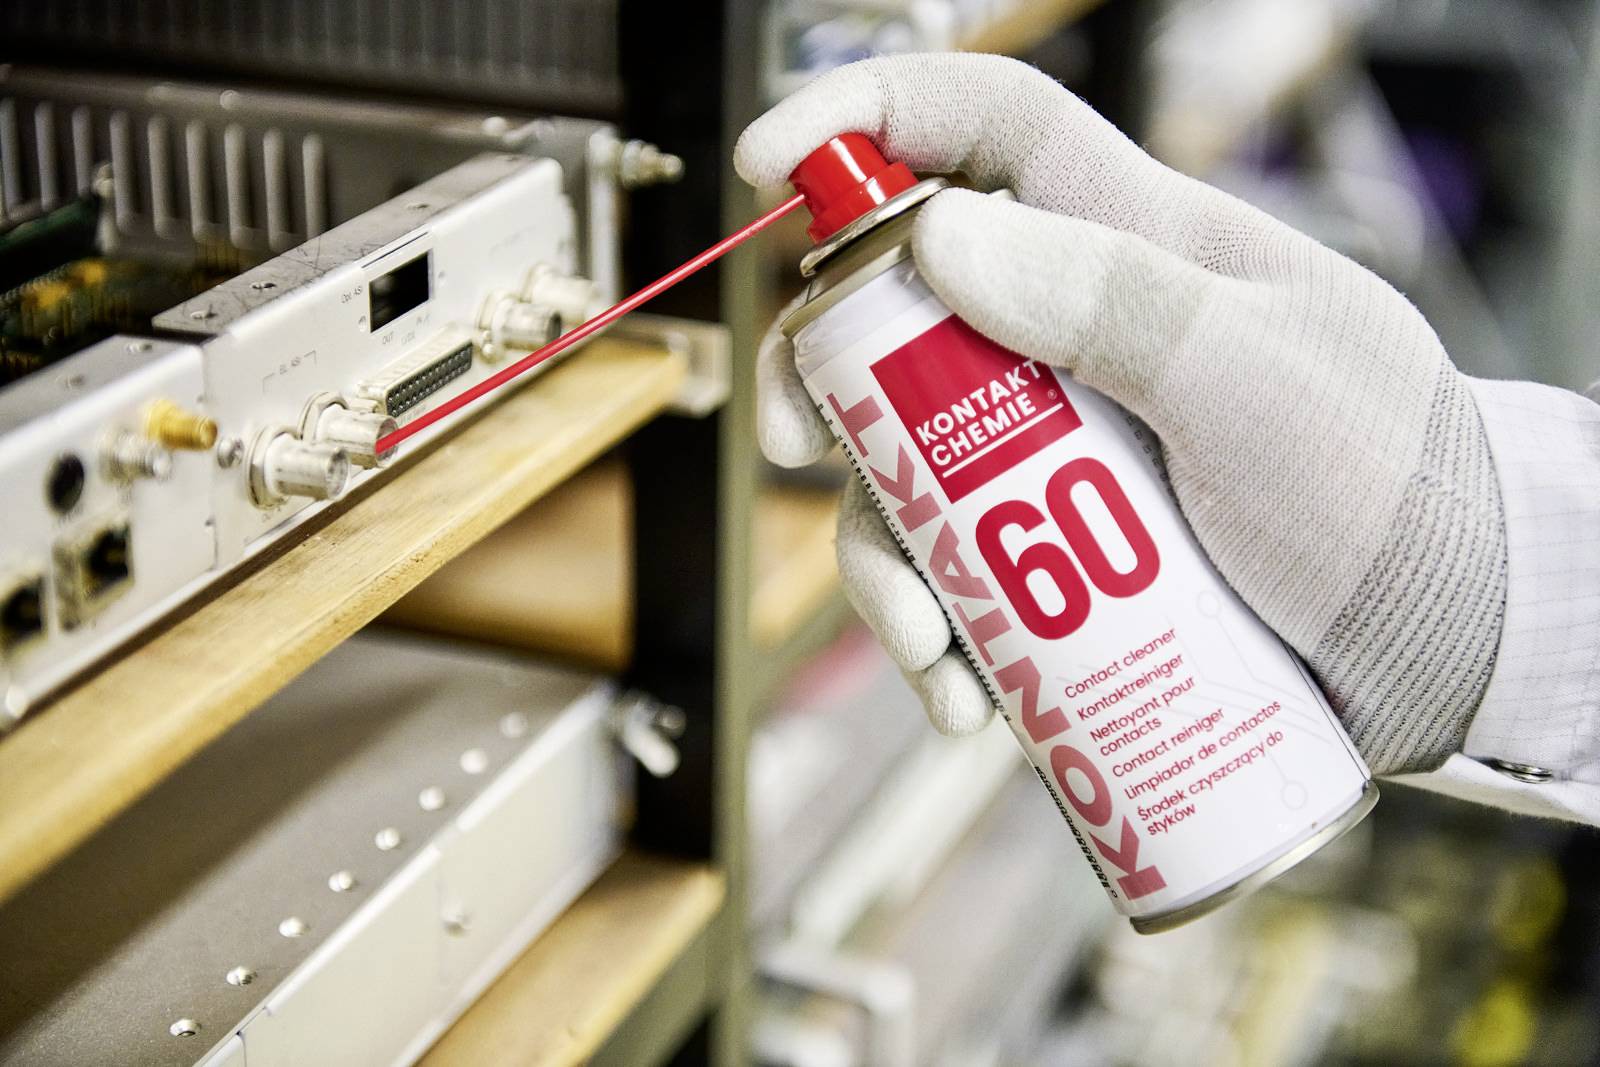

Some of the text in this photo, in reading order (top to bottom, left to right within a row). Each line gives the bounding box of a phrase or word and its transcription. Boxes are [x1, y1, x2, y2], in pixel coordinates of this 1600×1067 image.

[915, 359, 1040, 446] KONTAKT
[931, 392, 1037, 466] CHEMIE
[975, 457, 1161, 640] 60
[826, 392, 1166, 900] KONTAKT
[1064, 628, 1177, 699] Contact cleaner
[1076, 653, 1184, 721] Kontaktreiniger
[1089, 676, 1196, 744] Nettoyant pour
[1100, 717, 1163, 757] contacts
[1112, 708, 1225, 778] Contact reiniger
[1124, 700, 1282, 800] Limpiador de contactos
[1137, 730, 1284, 821] Środek czyszczący do
[1147, 803, 1196, 836] styków
